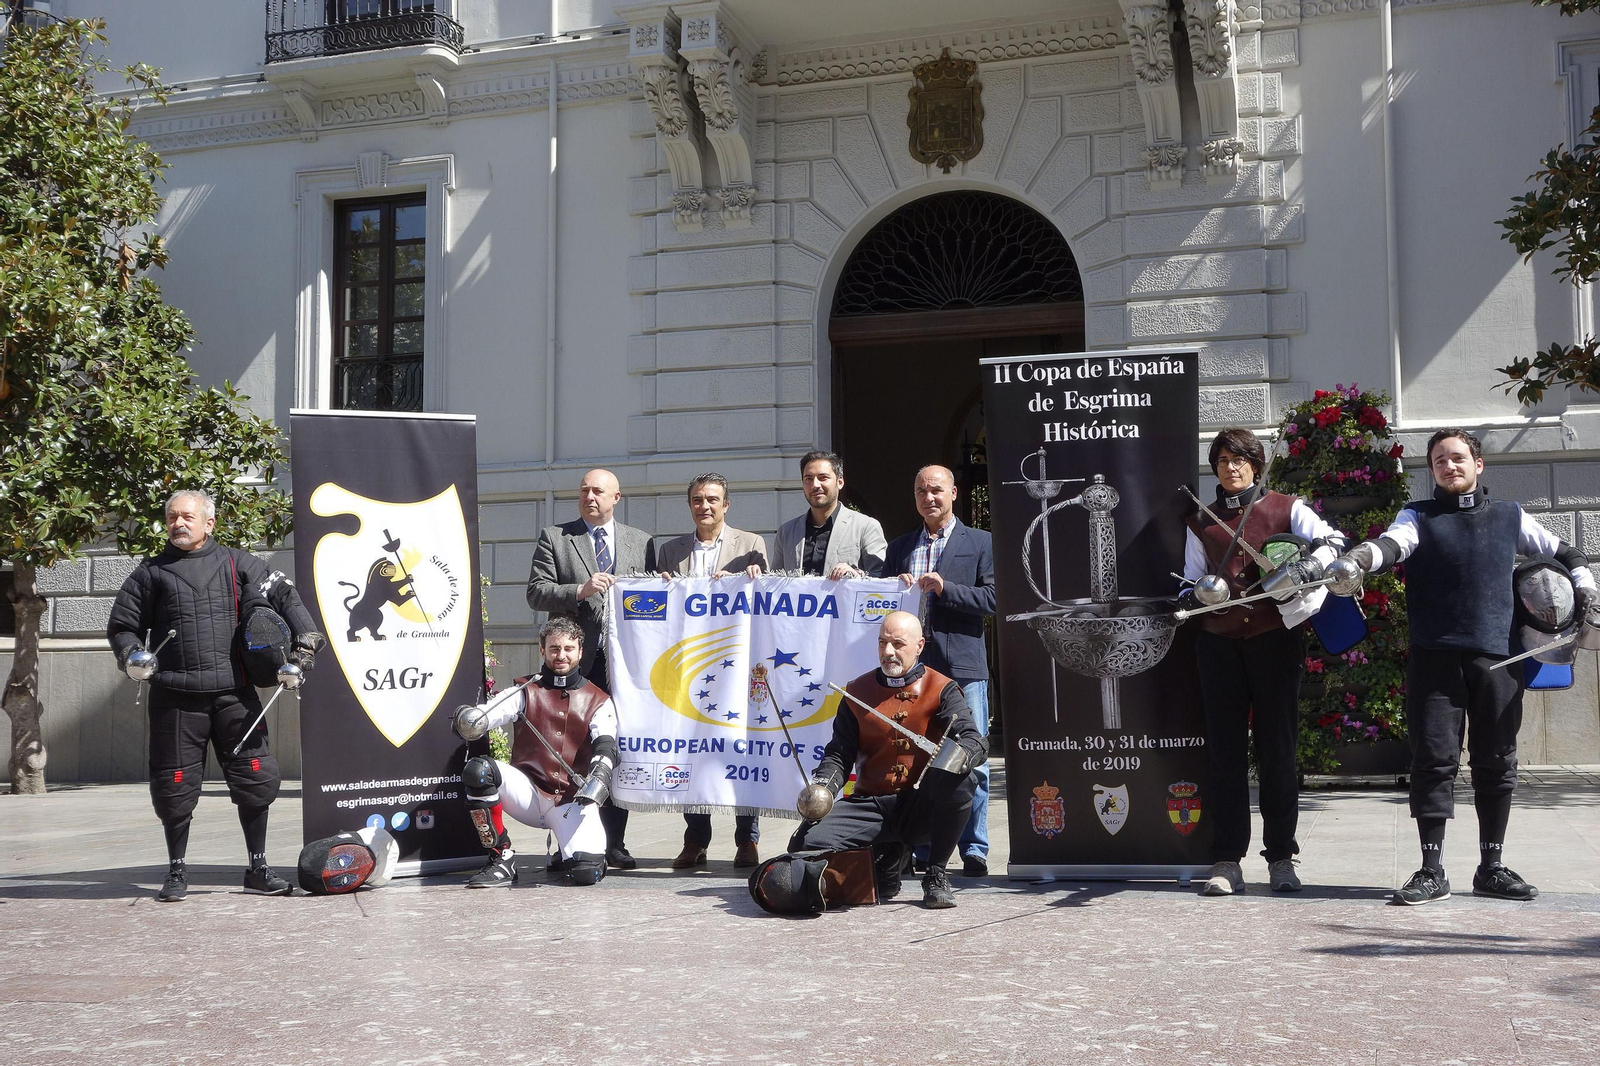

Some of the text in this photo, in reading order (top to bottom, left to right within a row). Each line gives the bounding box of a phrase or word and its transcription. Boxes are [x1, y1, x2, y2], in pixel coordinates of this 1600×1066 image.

[994, 356, 1185, 386] II Copa de España
[1028, 388, 1153, 414] de Esgrima
[1043, 419, 1140, 443] Histórica
[429, 555, 459, 621] Sala de Armas
[684, 591, 839, 619] GRANADA
[866, 600, 898, 609] aces
[396, 629, 450, 639] de Granada
[363, 667, 433, 691] SAGr
[618, 736, 725, 754] EUROPEAN
[733, 738, 775, 757] CITY
[779, 742, 806, 759] OF
[1018, 734, 1205, 752] Granada, 30 y 31 de marzo
[724, 764, 770, 783] 2019
[1082, 756, 1141, 771] de 2019
[665, 771, 690, 779] aces
[336, 791, 459, 809] esgrimasagr@hotmail.es
